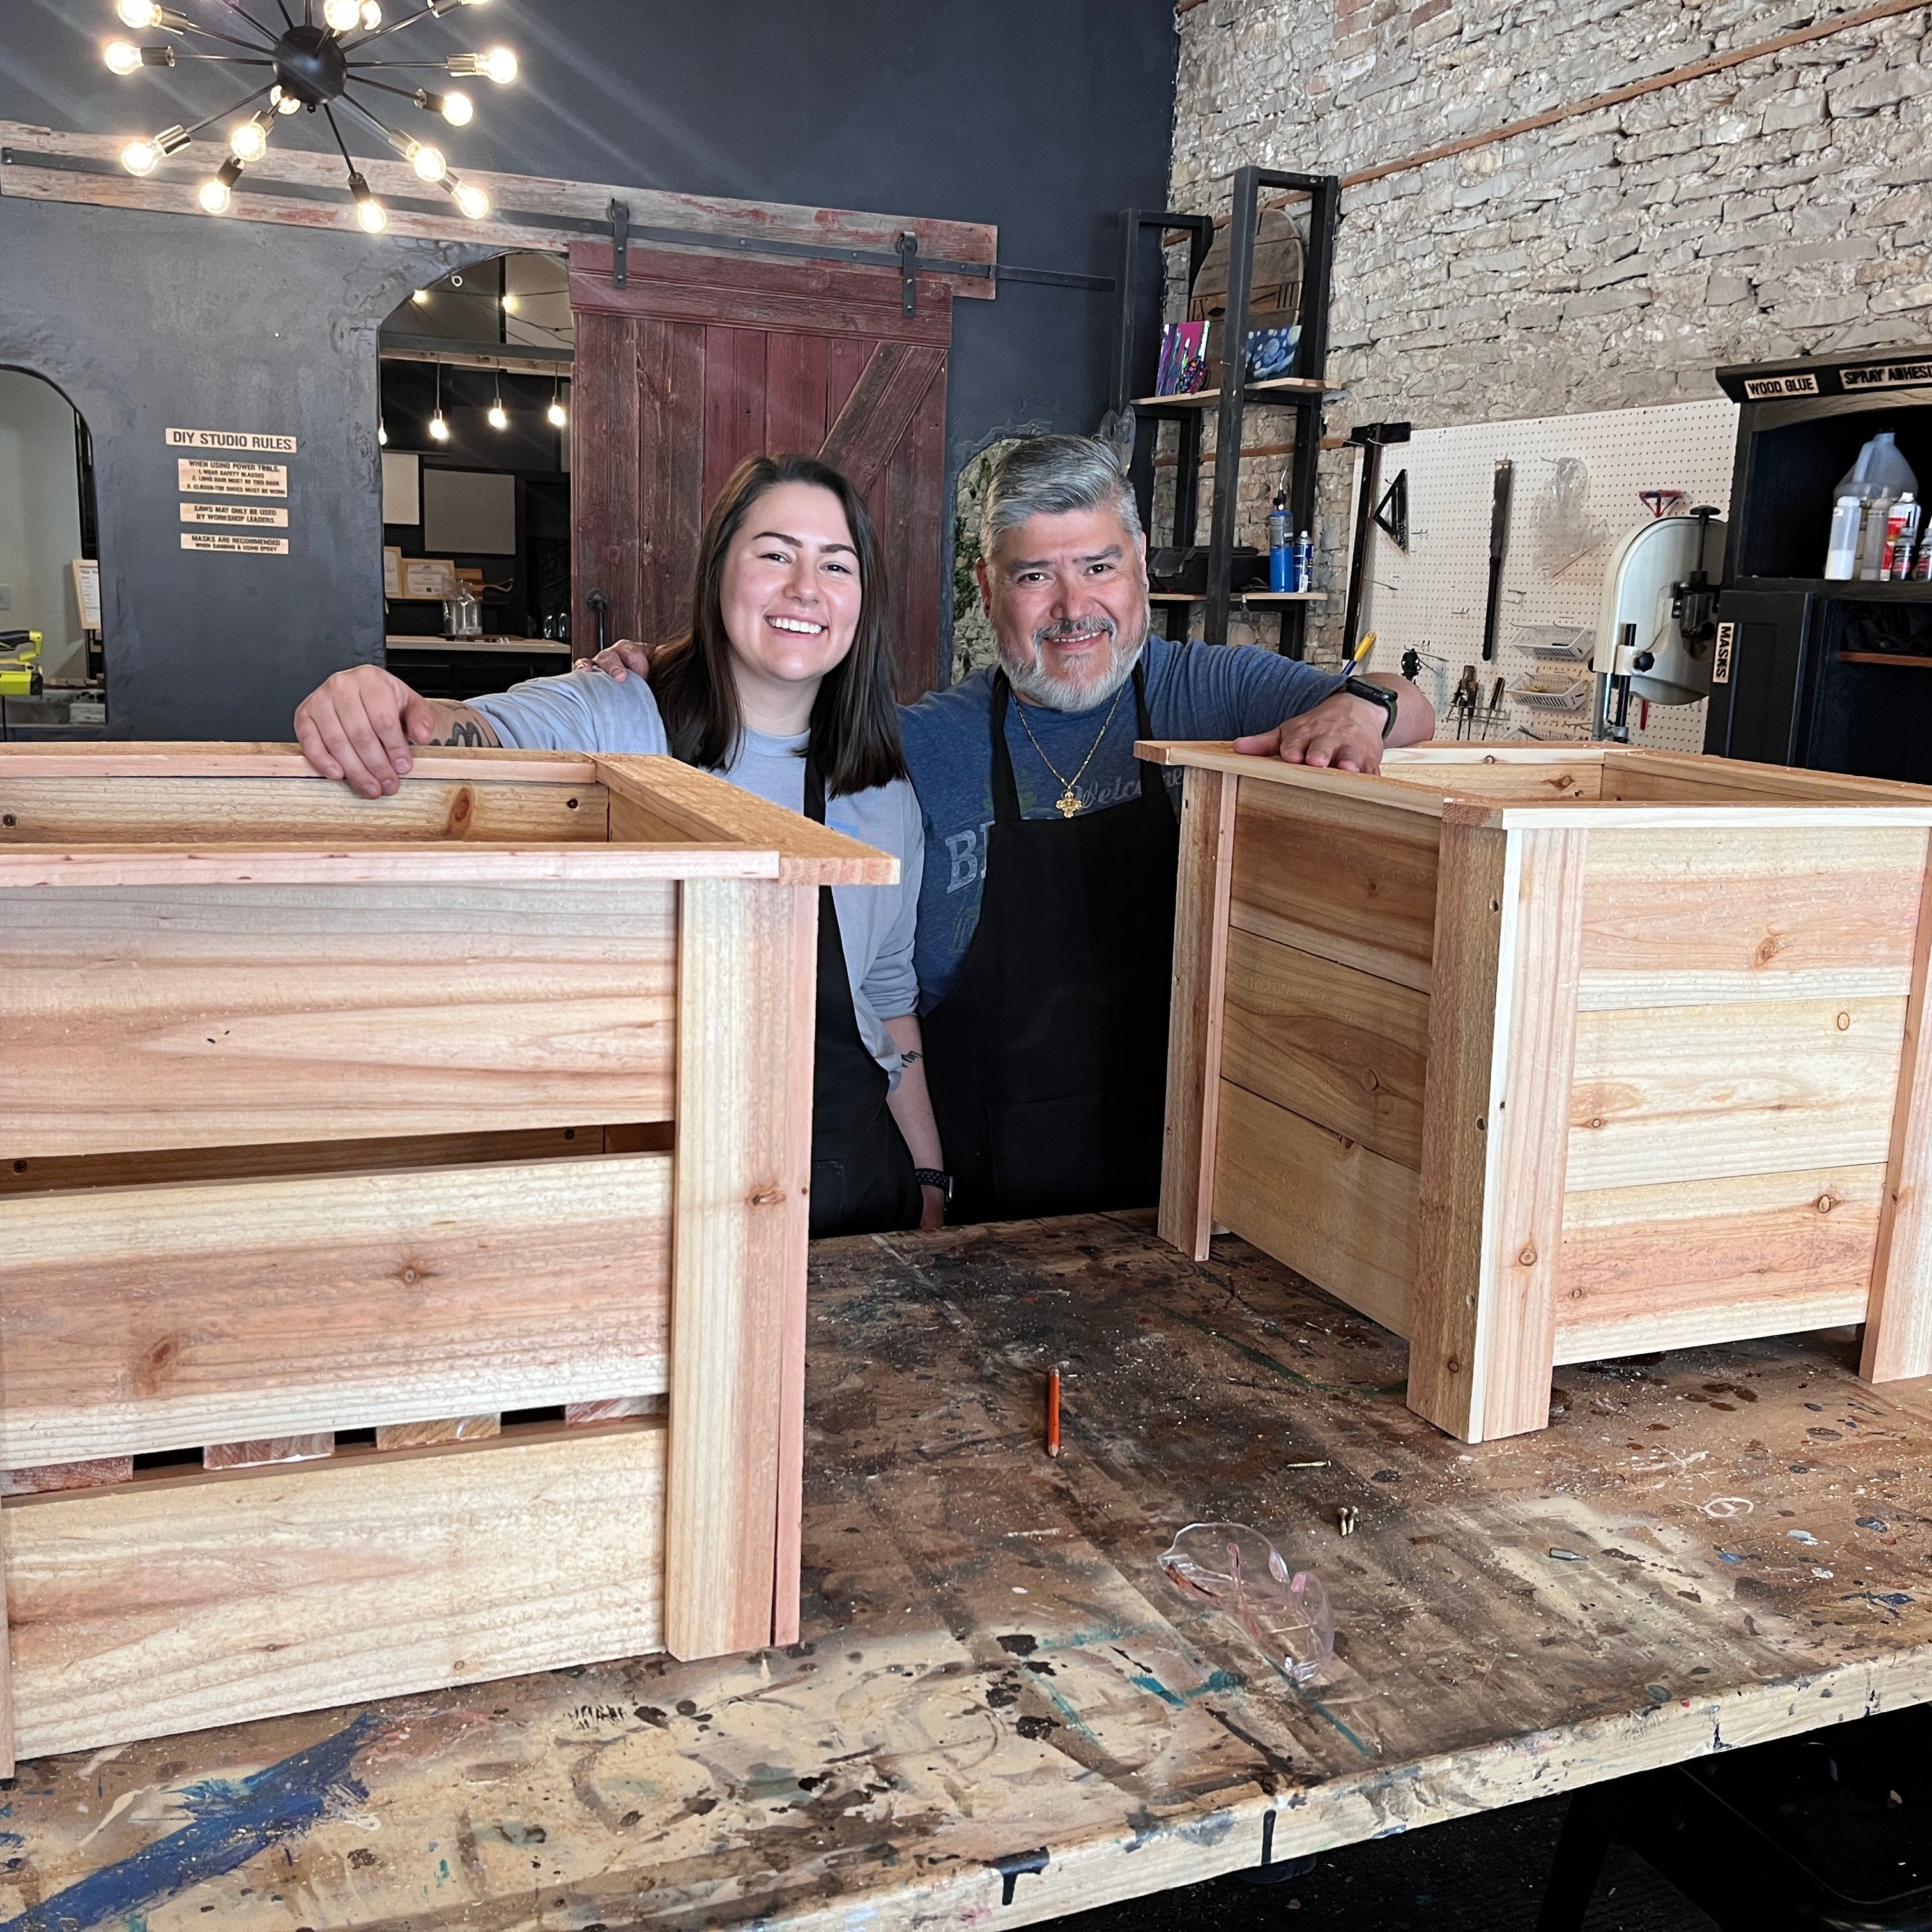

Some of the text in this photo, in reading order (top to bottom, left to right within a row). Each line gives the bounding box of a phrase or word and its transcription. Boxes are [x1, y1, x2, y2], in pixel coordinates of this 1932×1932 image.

[1844, 365, 1932, 384] SPRAY ADHESI
[1748, 378, 1814, 395] WOOD GLUE
[173, 431, 292, 450] DIY STUDIO RULES
[189, 459, 208, 468] WHEN
[210, 461, 230, 470] USING
[207, 514, 245, 522] WORKSHOP
[232, 538, 280, 546] RECOMMENDED
[1716, 626, 1731, 678] MASKS
